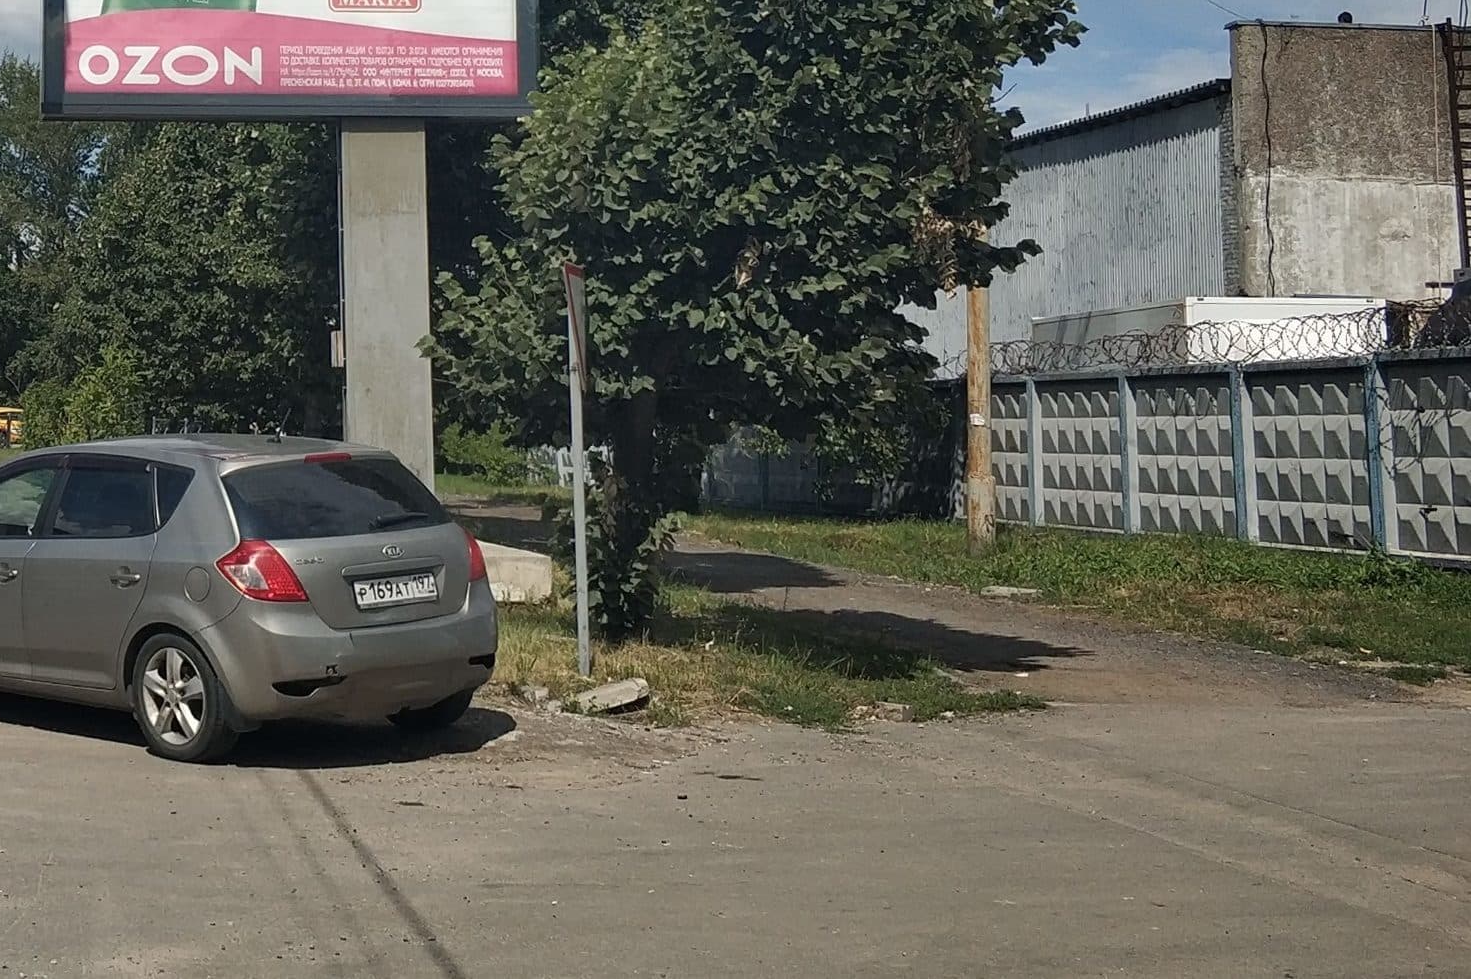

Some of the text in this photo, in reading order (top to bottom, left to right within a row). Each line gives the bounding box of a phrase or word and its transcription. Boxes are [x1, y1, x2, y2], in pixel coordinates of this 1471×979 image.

[280, 45, 304, 55] ПЕРИОД
[305, 45, 343, 55] ПРОВЕДЕНИЯ
[345, 45, 366, 56] АКЦИИ
[396, 46, 406, 55] ПО
[431, 46, 460, 56] ИМЕЮТСЯ
[461, 46, 504, 56] ОГРАНИЧЕНИЯ
[78, 44, 263, 86] OZON
[280, 56, 289, 65] ПО
[322, 56, 360, 66] КОЛИЧЕСТВО
[360, 56, 387, 66] ТОВАРОВ
[462, 57, 472, 66] ОБ
[362, 67, 377, 76] ООО
[386, 547, 401, 556] KIA
[358, 574, 431, 601] Р169АТ 197
